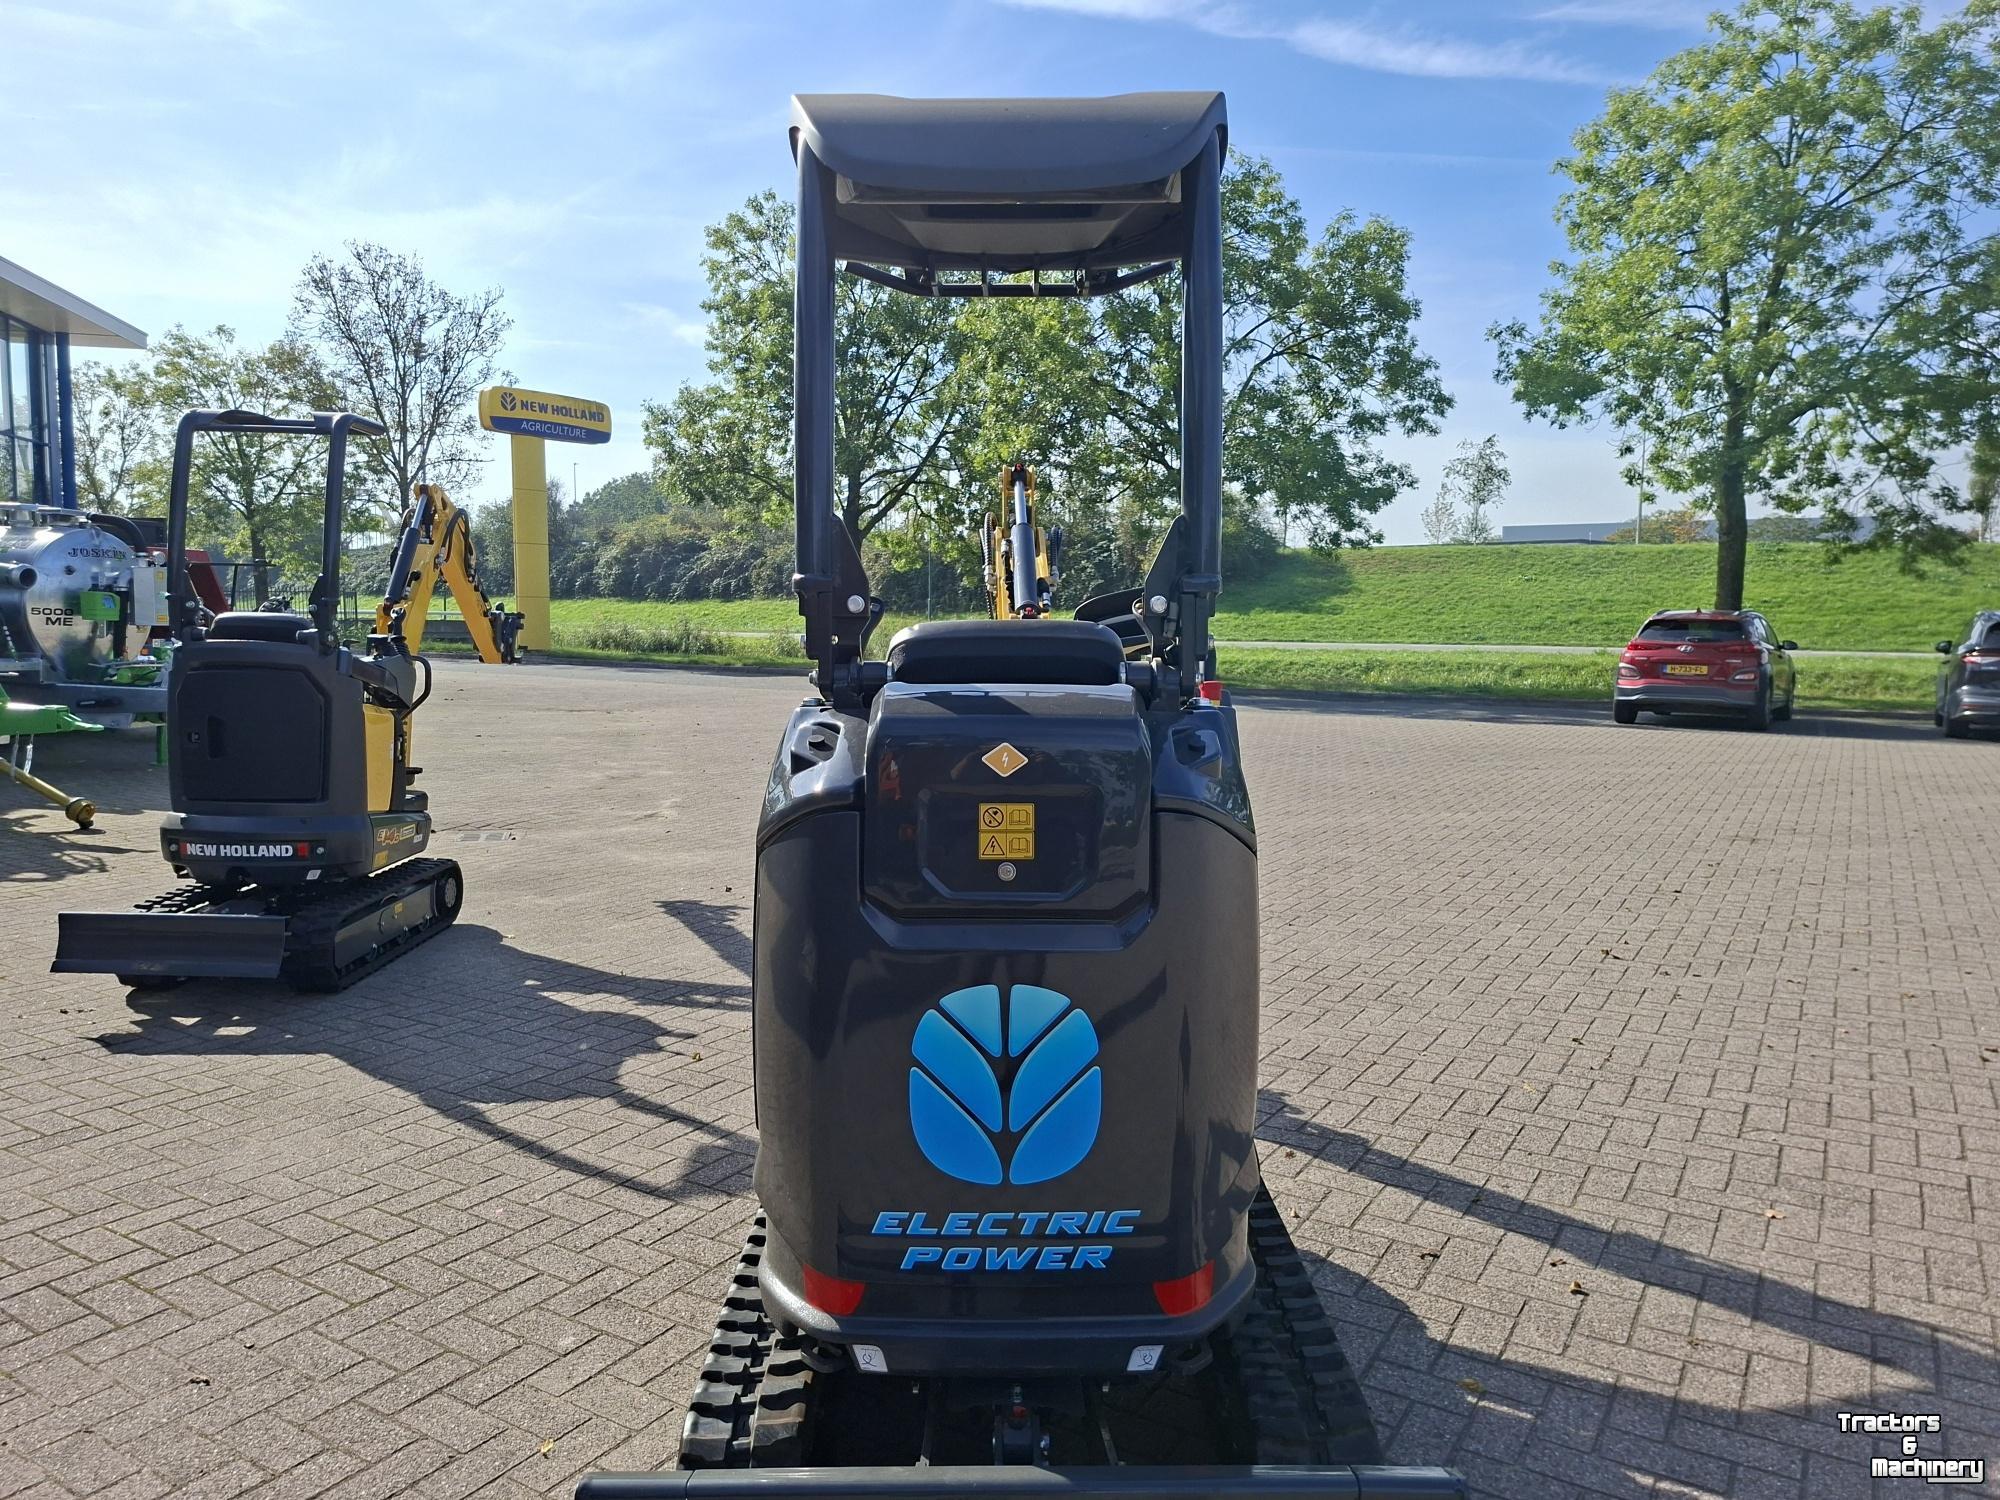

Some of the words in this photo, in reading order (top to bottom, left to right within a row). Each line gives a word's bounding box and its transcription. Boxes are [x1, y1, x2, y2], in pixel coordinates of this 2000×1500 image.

[520, 399, 548, 414] NEW
[551, 404, 605, 423] HOLLAND
[520, 420, 587, 439] AGRICULTURE
[31, 607, 74, 616] 5000
[45, 616, 73, 627] ME
[186, 843, 217, 857] NEW
[220, 844, 293, 857] HOLLAND
[871, 1210, 1141, 1236] ELECTRIC
[900, 1246, 1113, 1271] POWER
